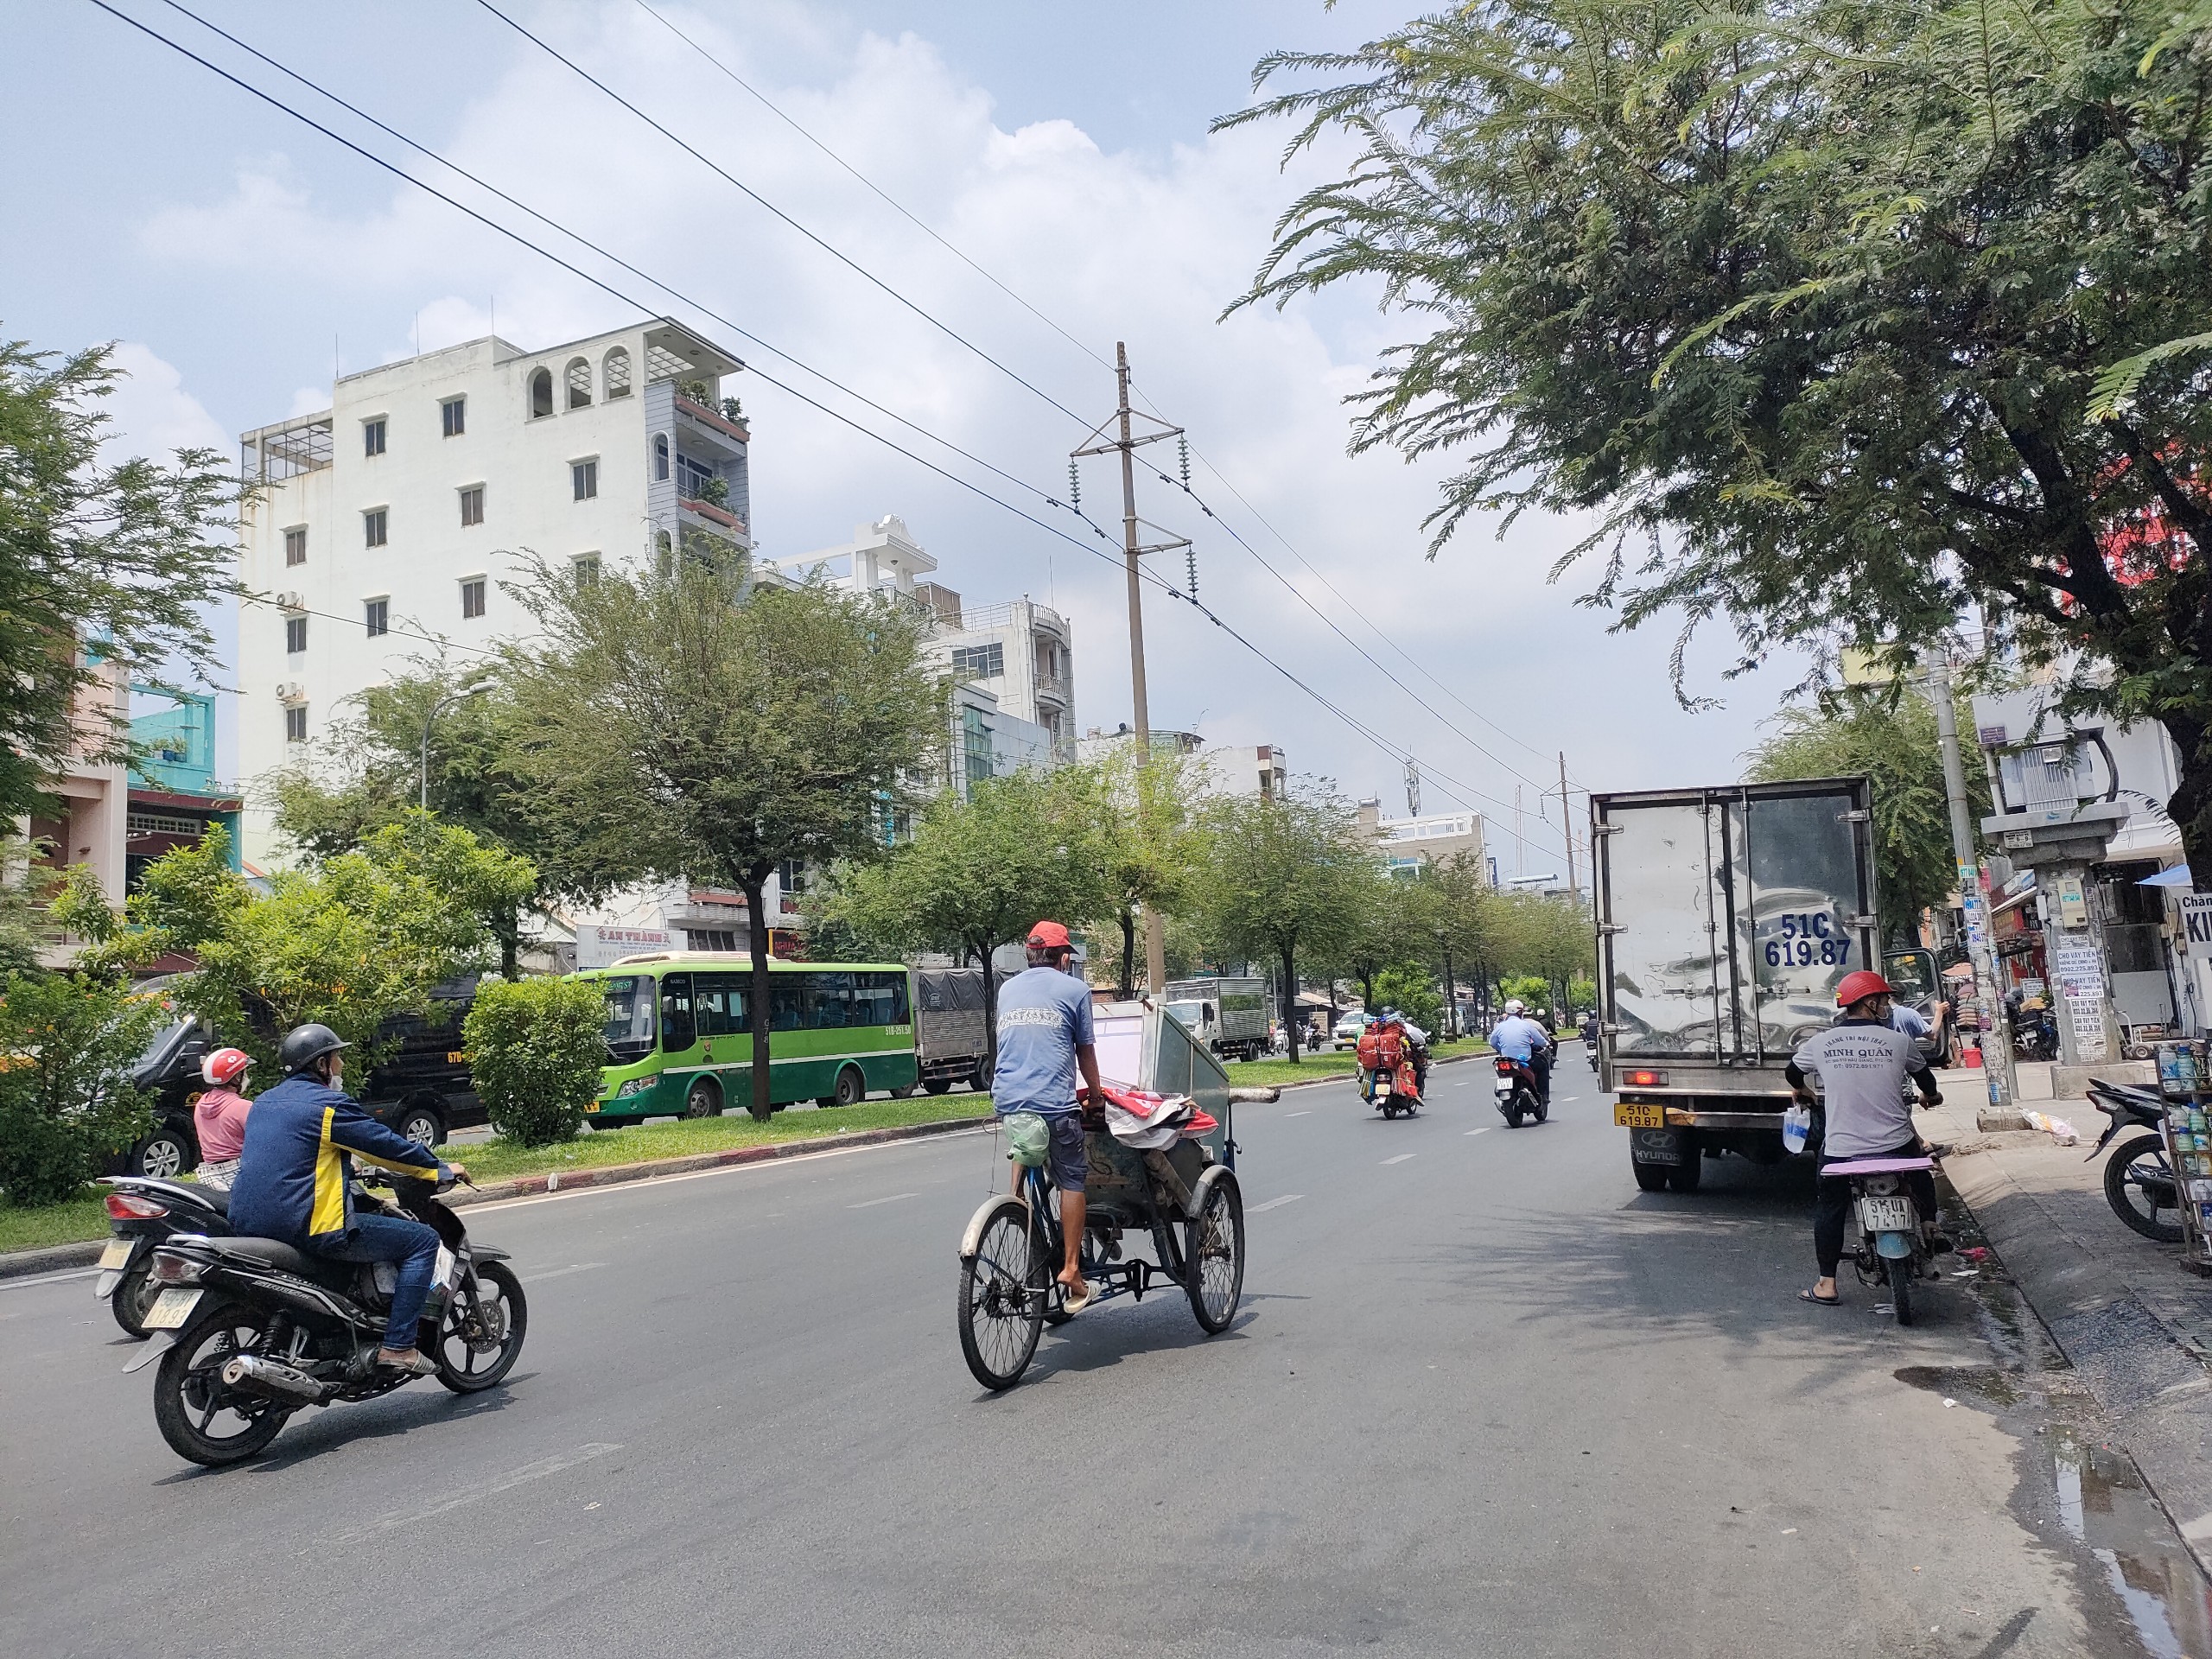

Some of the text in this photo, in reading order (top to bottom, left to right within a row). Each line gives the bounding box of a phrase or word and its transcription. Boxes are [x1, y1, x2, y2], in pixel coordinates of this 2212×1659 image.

[1782, 912, 1828, 939] 51C
[607, 931, 623, 940] AN
[1765, 939, 1850, 967] 619.87
[1823, 1047, 1893, 1058] MINH QUÂN
[1627, 1106, 1650, 1116] 51C
[1620, 1116, 1658, 1126] 619.87
[1636, 1150, 1681, 1160] HYUNDA
